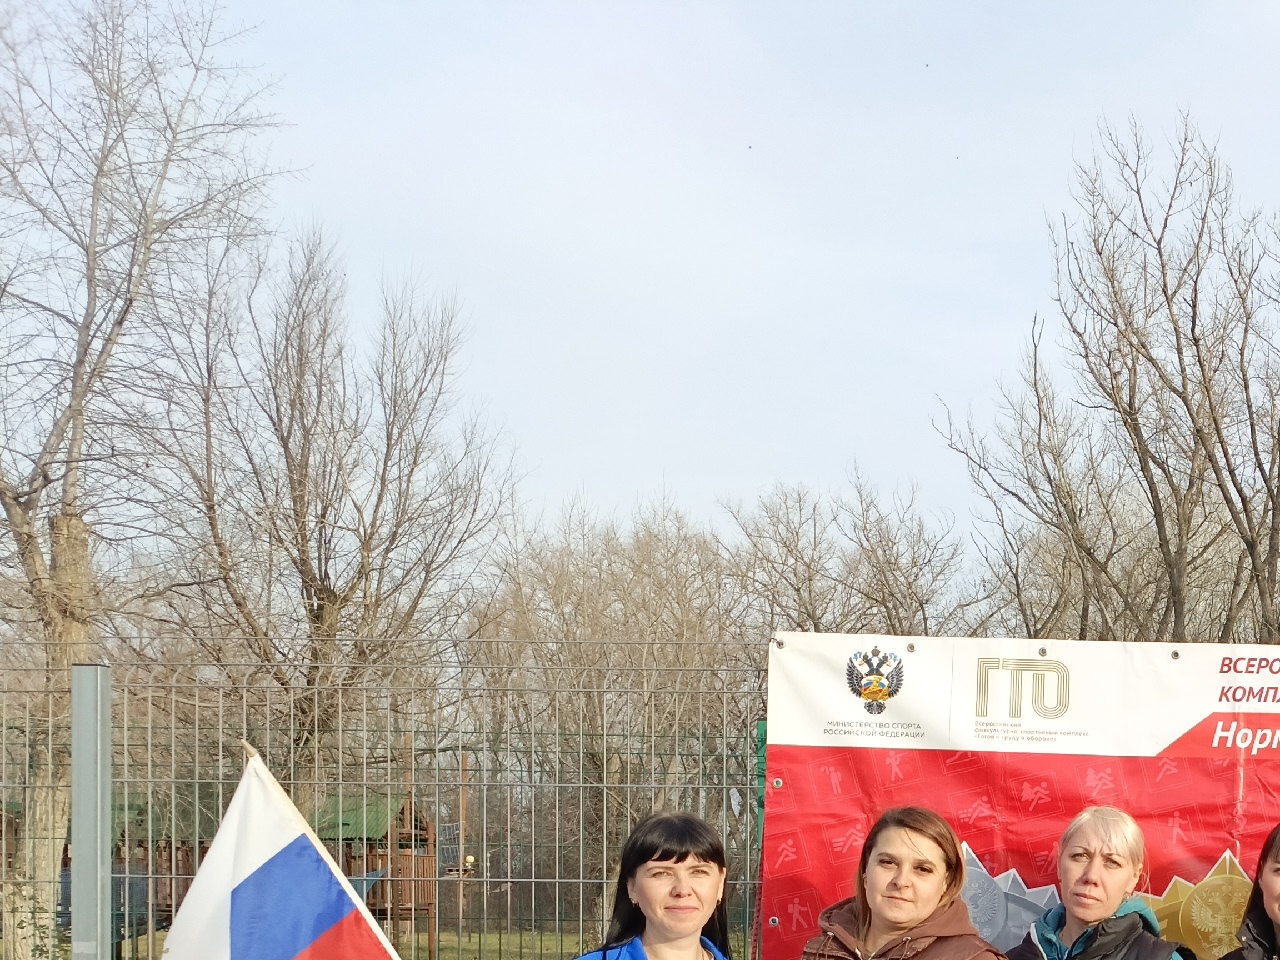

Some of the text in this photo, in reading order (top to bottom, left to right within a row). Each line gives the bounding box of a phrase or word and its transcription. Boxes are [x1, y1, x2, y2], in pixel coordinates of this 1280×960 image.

[976, 658, 1070, 719] ГТО
[827, 720, 922, 730] МИНИСТЕРСТВО СПОРТА
[823, 728, 925, 739] РОССИЙСКОЙ ФЕДЕРАЦИИ
